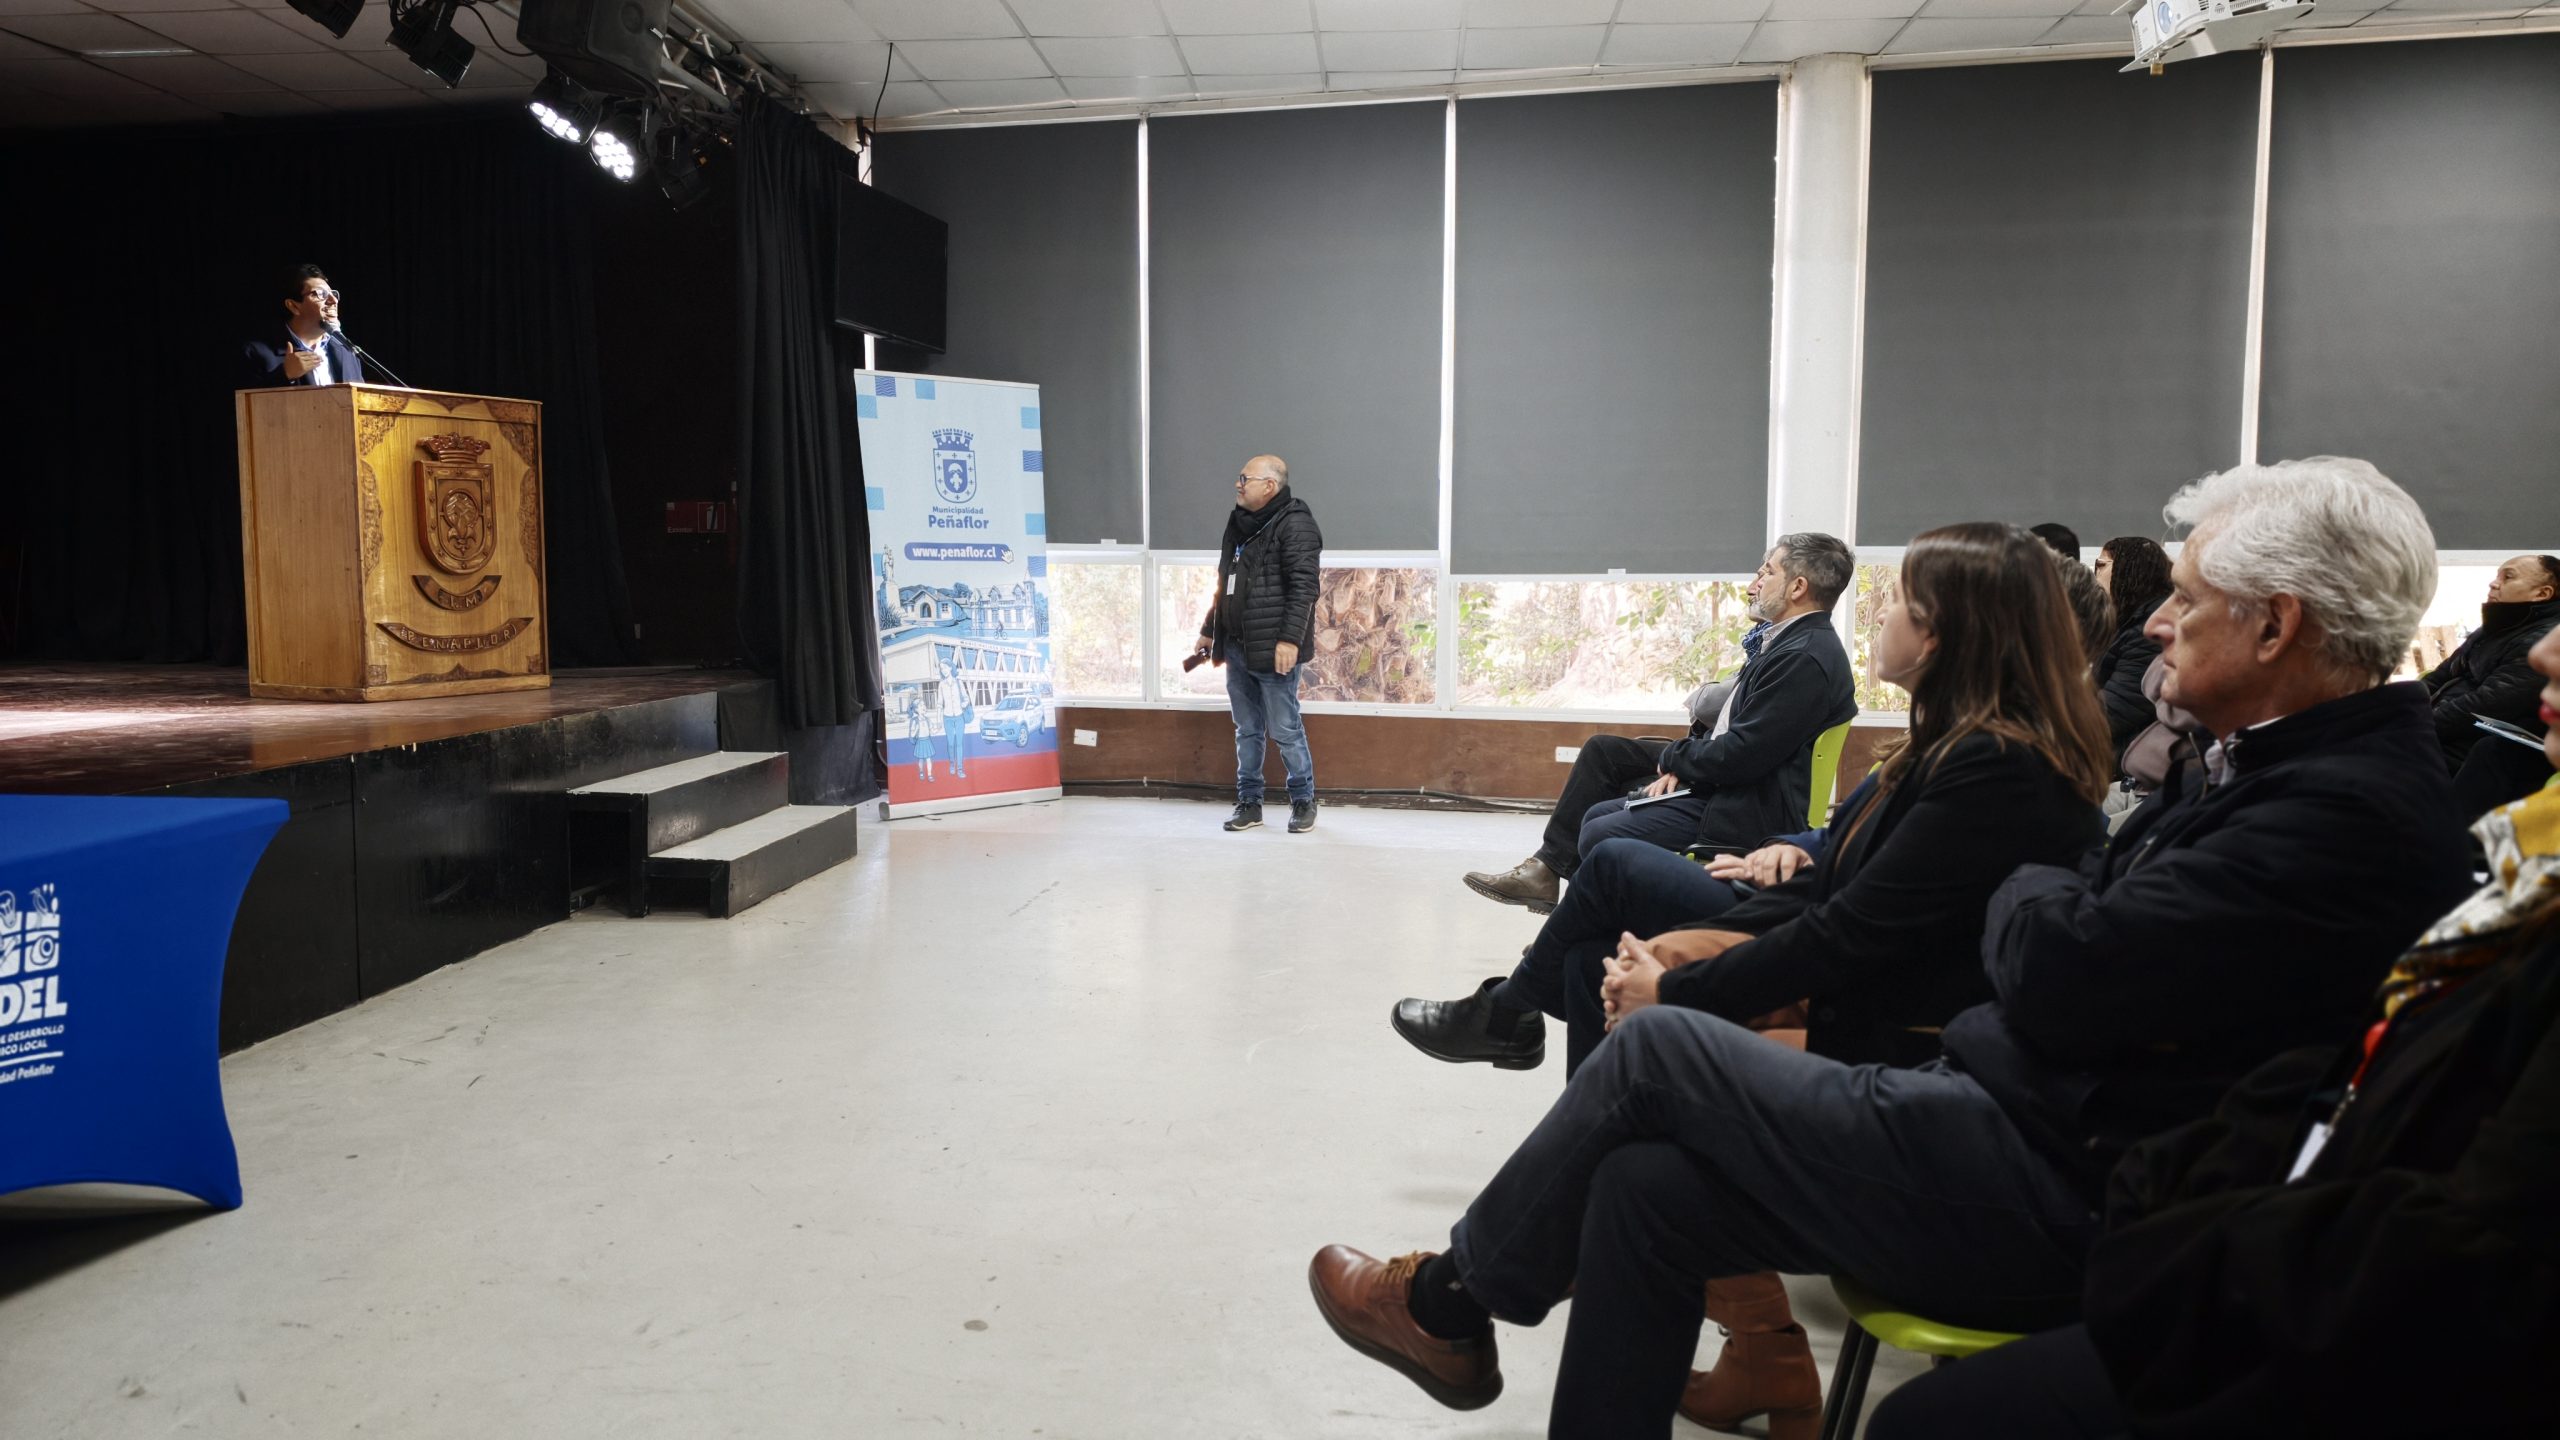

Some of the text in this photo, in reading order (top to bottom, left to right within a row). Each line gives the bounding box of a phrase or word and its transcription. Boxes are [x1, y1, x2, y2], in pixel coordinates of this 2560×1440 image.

[932, 506, 984, 515] Municipalidad
[928, 515, 989, 529] Peñaflor
[912, 546, 996, 560] www.penaflor.cl
[7, 1024, 65, 1042] DESARROLLO
[19, 1039, 48, 1052] LOCAL
